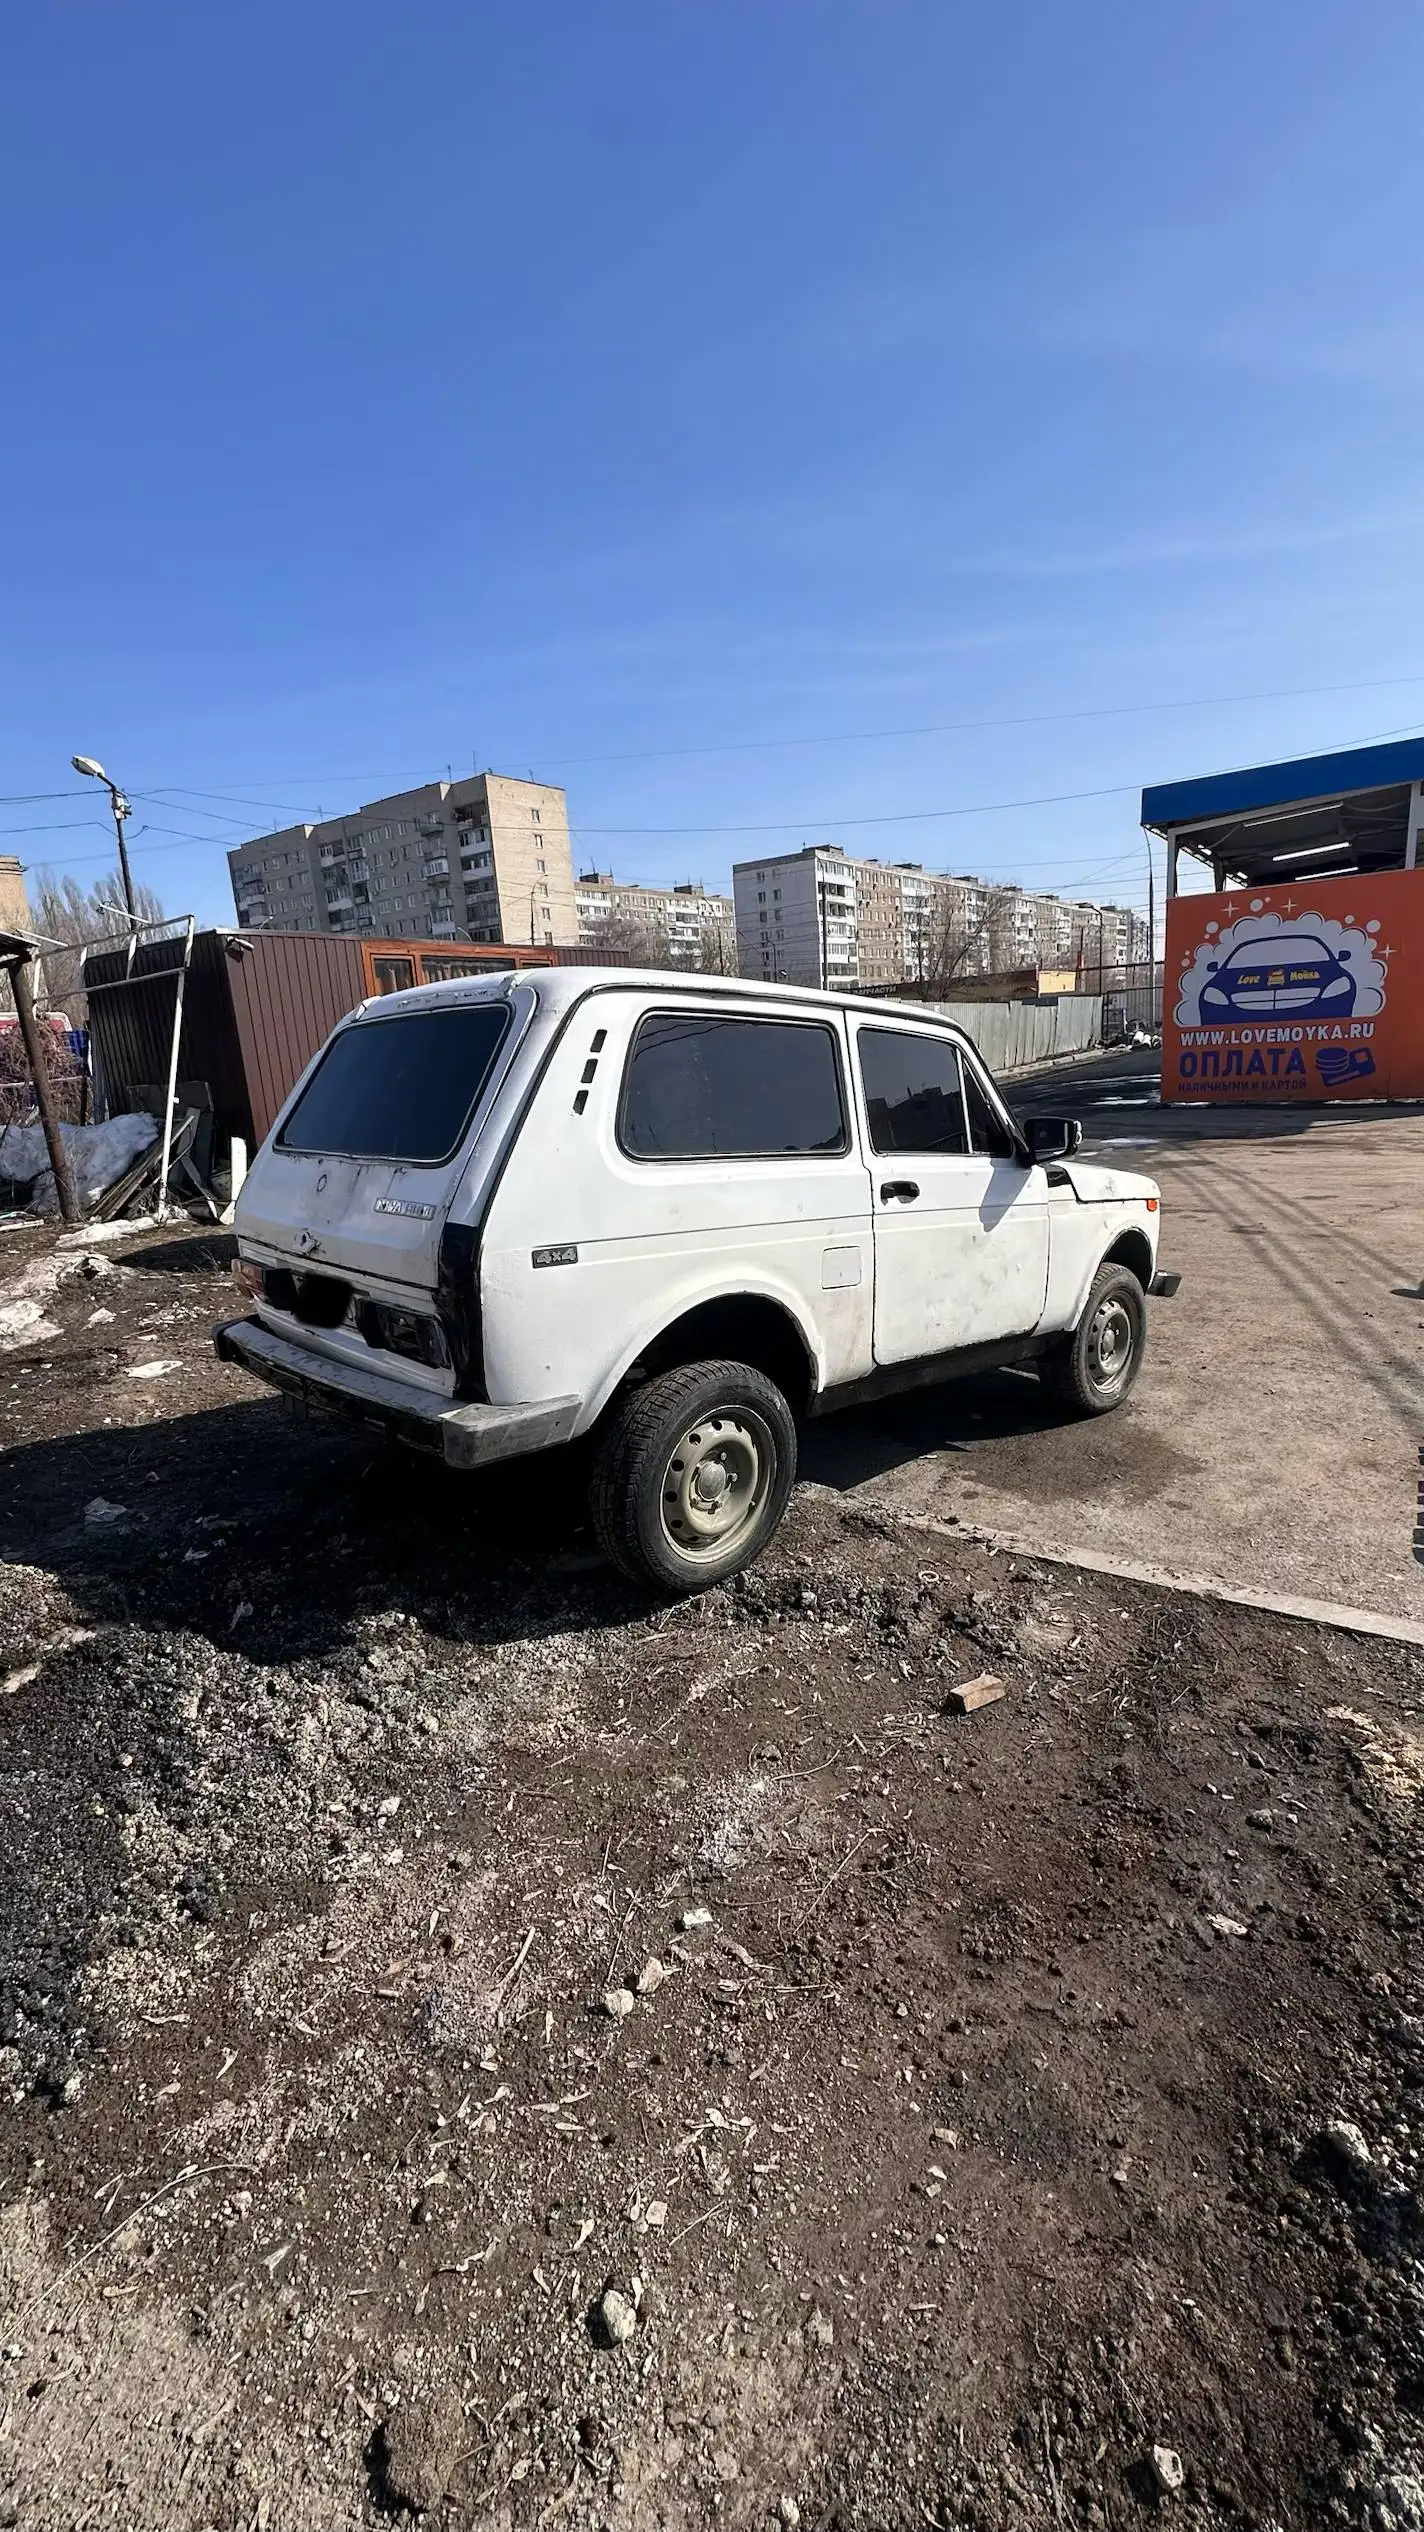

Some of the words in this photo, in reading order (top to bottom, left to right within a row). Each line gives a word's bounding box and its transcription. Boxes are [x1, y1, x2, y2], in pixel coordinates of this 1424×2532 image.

[1180, 1022, 1375, 1047] WWW.LOVEMOYKA.RU
[1179, 1047, 1307, 1078] ОПЛАТА
[1178, 1081, 1249, 1093] НАЛИЧНЫМИ
[1262, 1078, 1307, 1090] КАРТОЙ
